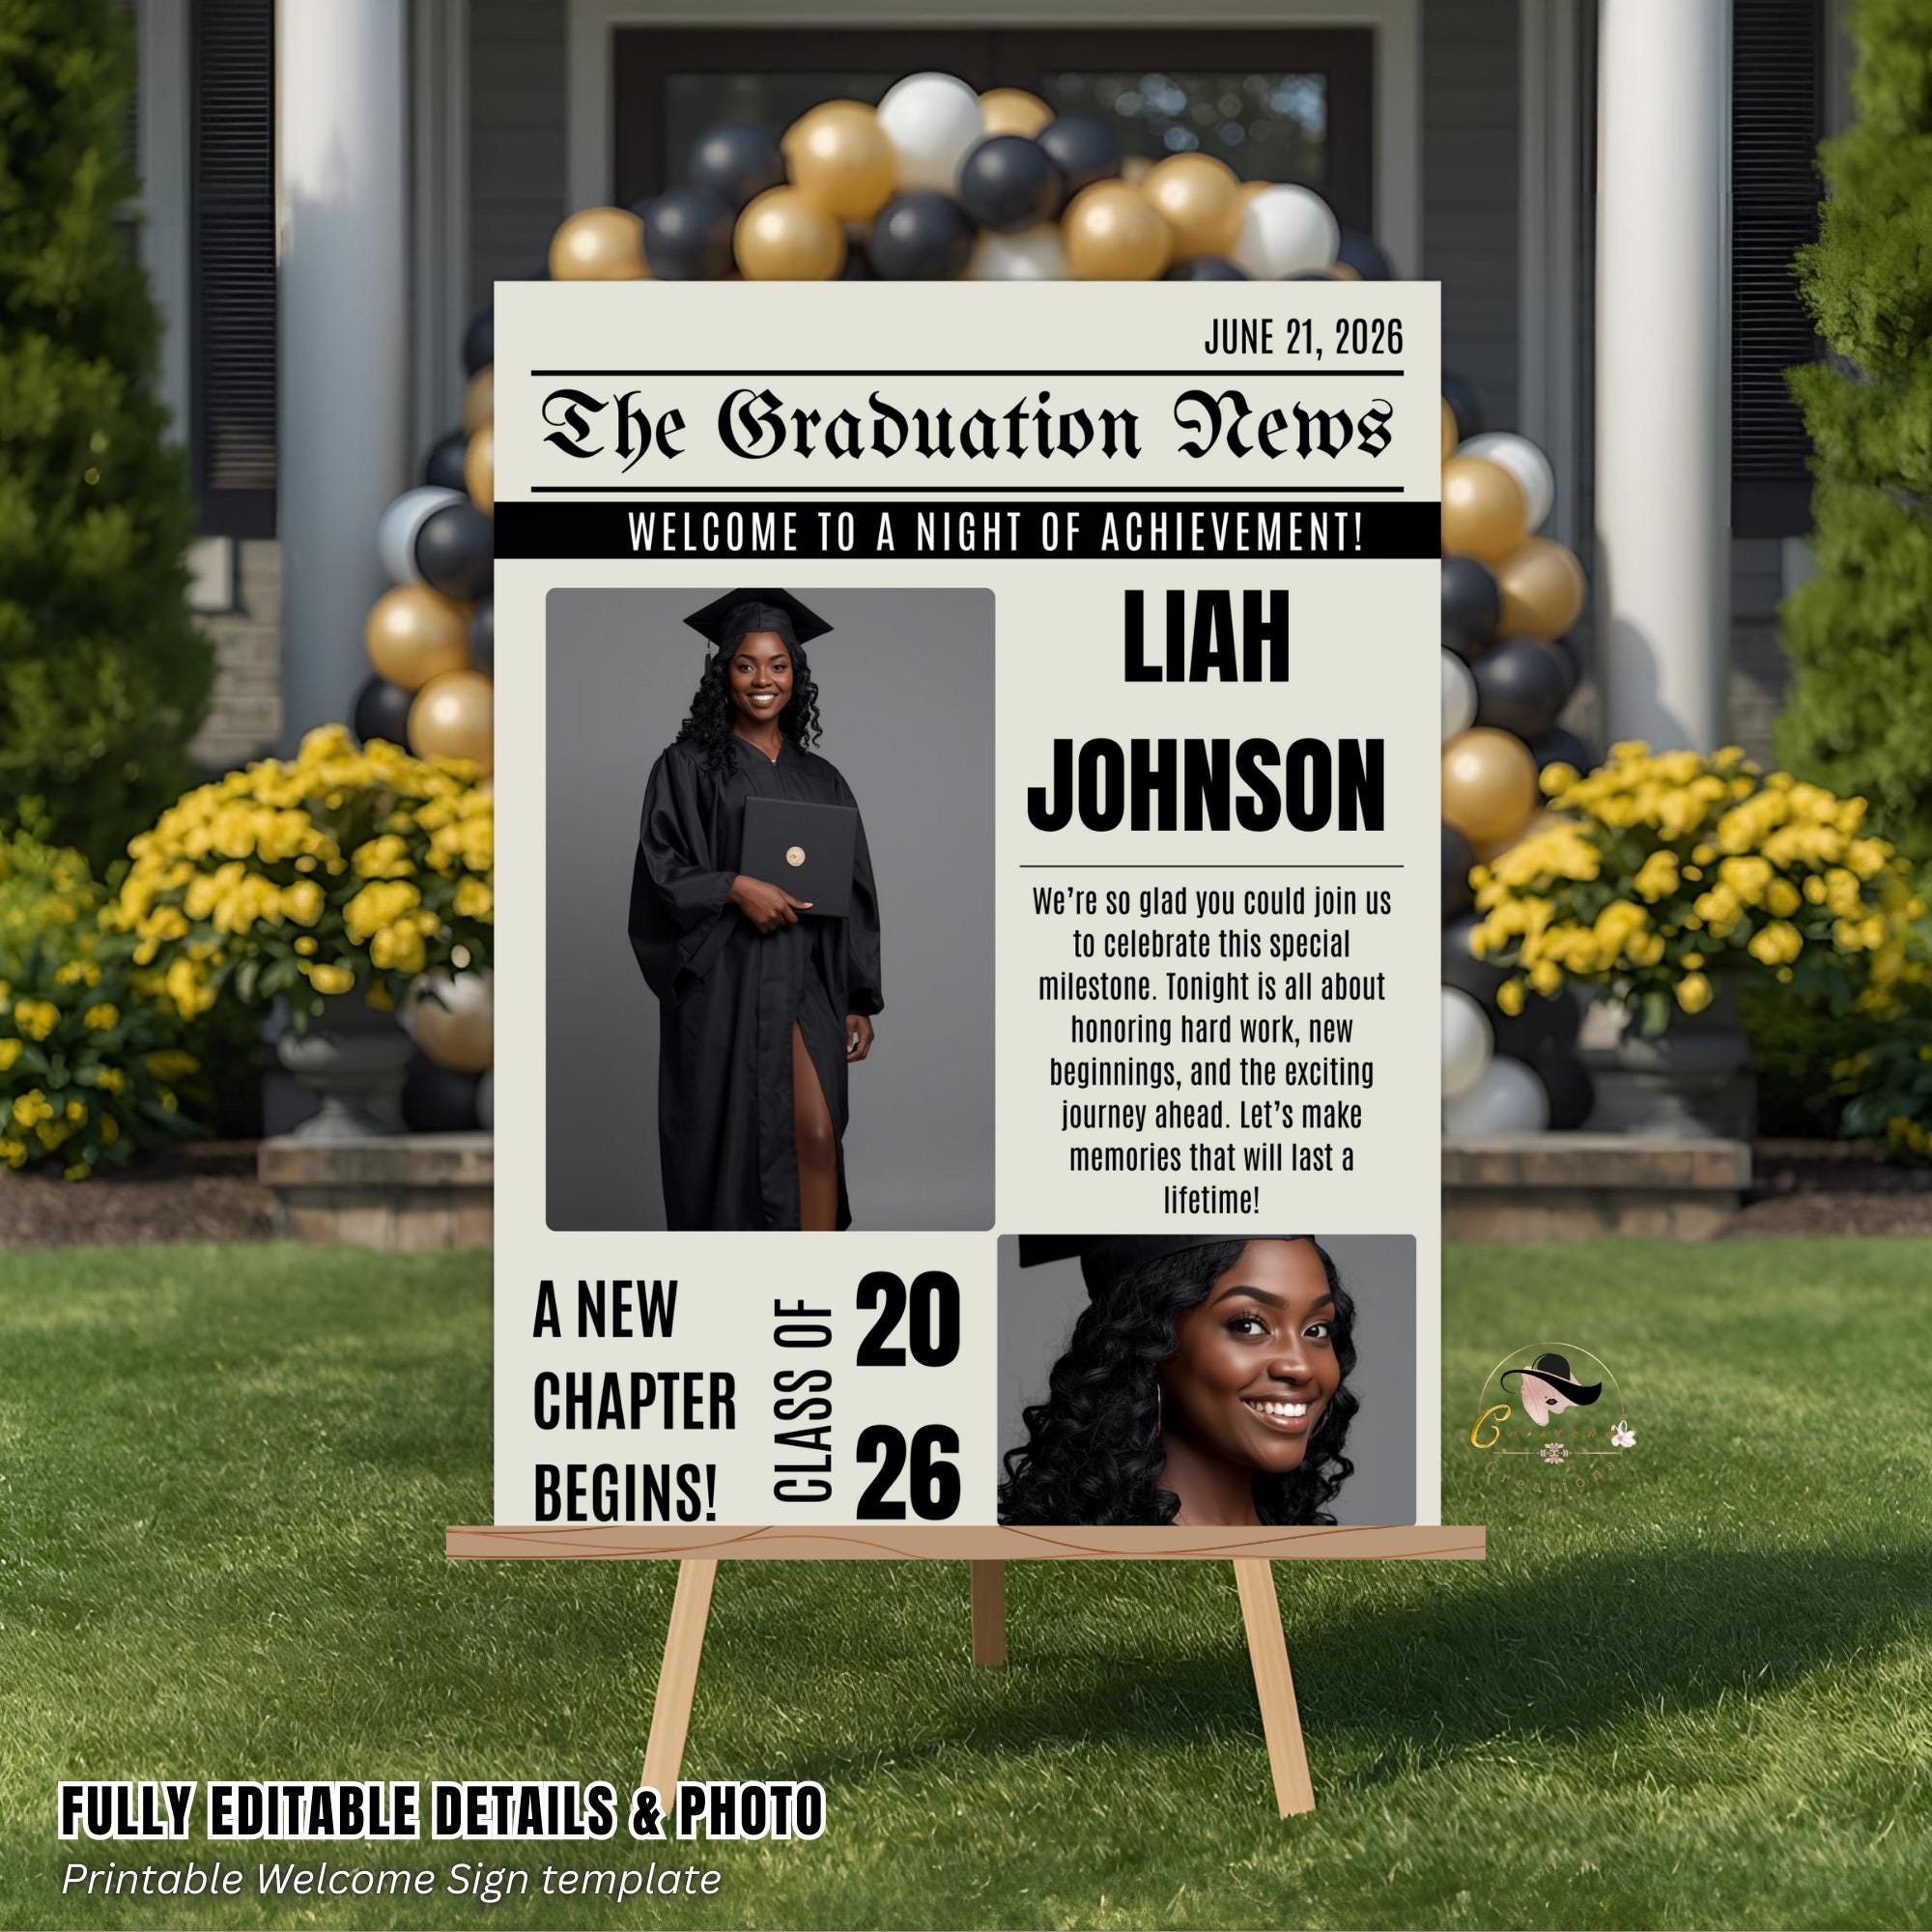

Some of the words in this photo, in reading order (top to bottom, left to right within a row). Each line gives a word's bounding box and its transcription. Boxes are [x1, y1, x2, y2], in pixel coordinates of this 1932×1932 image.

[1205, 319, 1272, 354] JUNE
[1288, 319, 1321, 360] 21,
[1336, 319, 1403, 354] 2026
[542, 389, 686, 473] The
[718, 389, 1142, 459] Graduation
[1174, 390, 1393, 459] News
[629, 512, 796, 551] WELCOME
[818, 512, 853, 551] TO
[877, 513, 894, 551] A
[918, 512, 1020, 551] NIGHT
[1042, 512, 1079, 551] OF
[1102, 512, 1360, 551] ACHIEVEMENT!
[1124, 590, 1289, 682] LIAH
[1028, 738, 1384, 832] JOHNSON
[1033, 887, 1096, 915] We’re
[1106, 891, 1129, 915] so
[1140, 887, 1186, 918] glad
[1196, 891, 1234, 918] you
[1244, 887, 1304, 915] could
[1315, 887, 1355, 918] join
[1367, 892, 1391, 915] us
[1073, 930, 1094, 957] to
[1105, 929, 1209, 957] celebrate
[1219, 929, 1261, 957] this
[1270, 929, 1349, 961] special
[1039, 972, 1156, 1000] milestone.
[1166, 972, 1249, 1003] Tonight
[1259, 972, 1276, 1000] is
[1286, 973, 1311, 1000] all
[1321, 973, 1385, 1000] about
[1072, 1014, 1171, 1045] honoring
[1182, 1015, 1230, 1042] hard
[1240, 1015, 1299, 1047] work,
[1310, 1019, 1352, 1042] new
[1051, 1058, 1180, 1090] beginnings,
[1191, 1058, 1230, 1086] and
[1240, 1058, 1275, 1086] the
[1286, 1058, 1373, 1089] exciting
[1062, 1100, 1146, 1131] journey
[1156, 1100, 1230, 1128] ahead.
[1241, 1100, 1293, 1128] Let’s
[1303, 1101, 1361, 1128] make
[1071, 1143, 1180, 1171] memories
[1190, 1144, 1236, 1171] that
[1244, 1143, 1281, 1171] will
[1293, 1144, 1333, 1171] last
[1343, 1148, 1353, 1171] a
[1165, 1185, 1259, 1213] lifetime!
[533, 1280, 561, 1337] A
[579, 1280, 678, 1337] NEW
[774, 1299, 832, 1348] OF
[857, 1271, 960, 1367] 20
[534, 1372, 735, 1430] CHAPTER
[774, 1370, 832, 1502] CLASS
[535, 1463, 716, 1521] BEGINS!
[857, 1424, 960, 1520] 26
